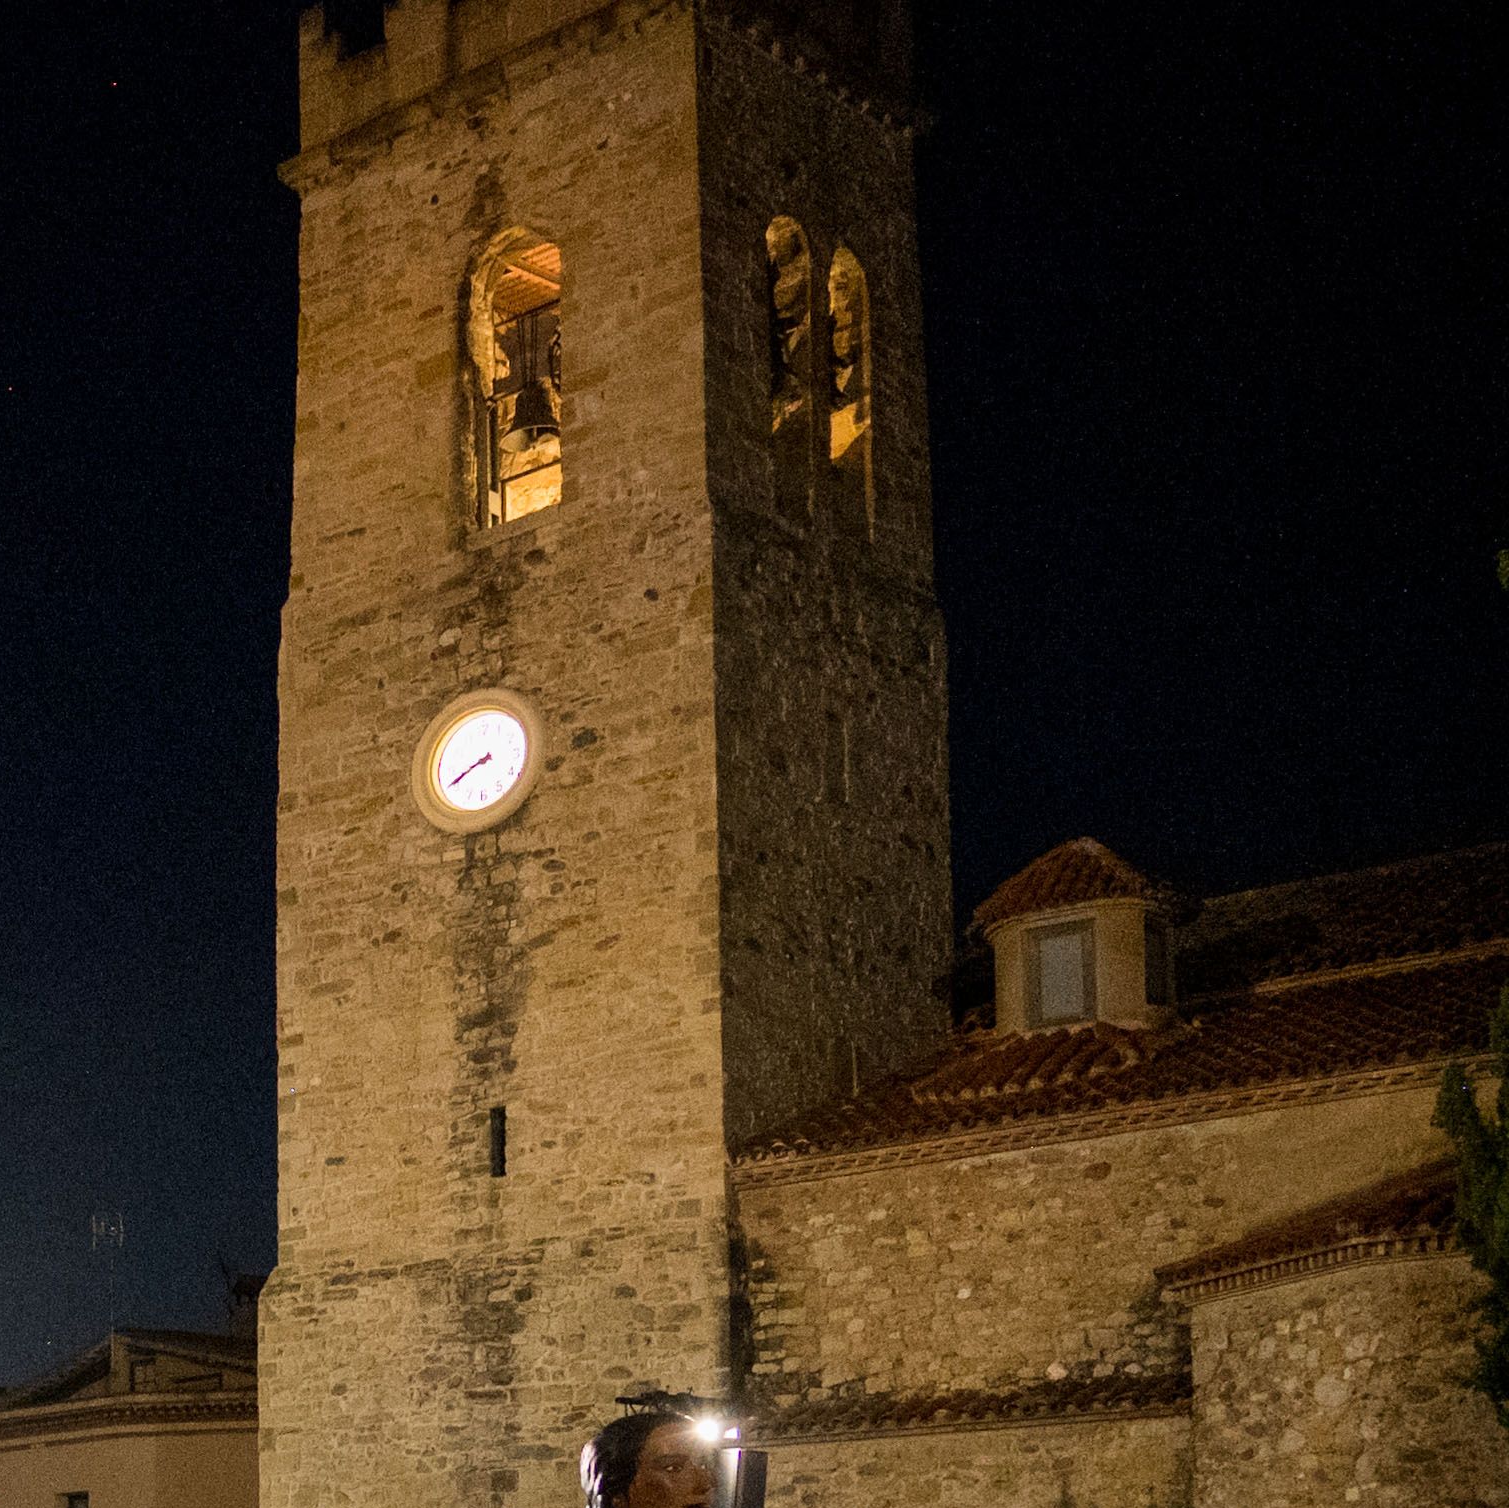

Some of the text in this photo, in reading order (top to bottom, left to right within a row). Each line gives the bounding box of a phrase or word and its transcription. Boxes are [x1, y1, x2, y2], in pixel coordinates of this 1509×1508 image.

[508, 765, 514, 776] 4
[495, 779, 503, 793] 5
[480, 788, 488, 801] 6
